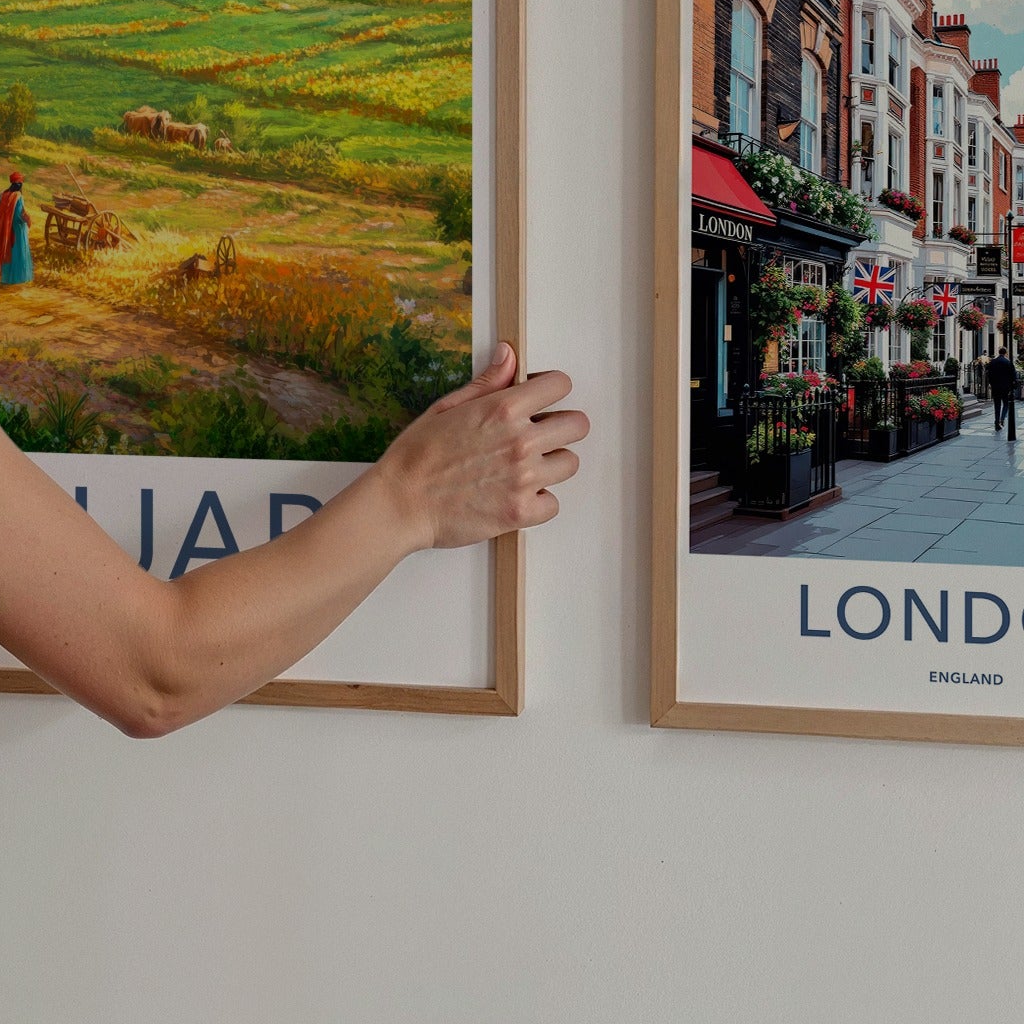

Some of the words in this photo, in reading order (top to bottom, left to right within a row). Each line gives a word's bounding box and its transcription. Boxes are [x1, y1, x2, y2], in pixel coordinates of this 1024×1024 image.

[698, 213, 753, 242] LONDON
[800, 584, 1024, 645] LOND
[929, 670, 1004, 686] ENGLAND
